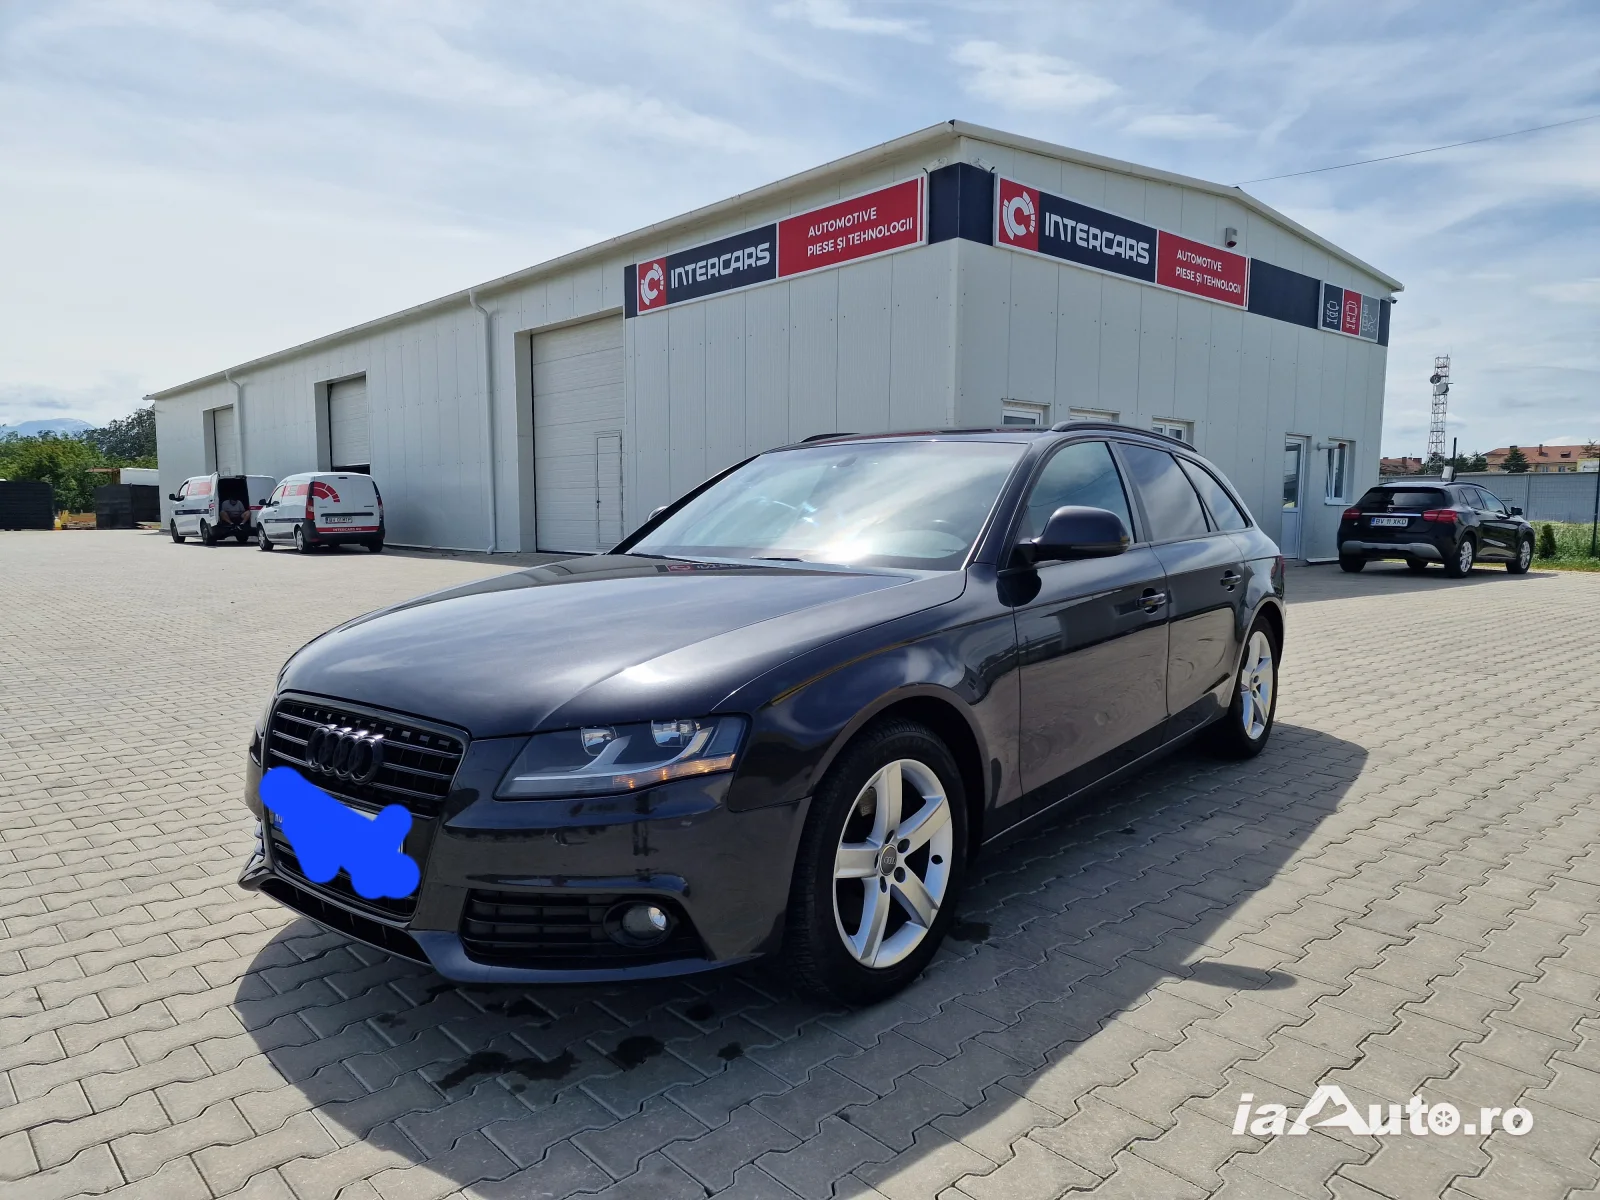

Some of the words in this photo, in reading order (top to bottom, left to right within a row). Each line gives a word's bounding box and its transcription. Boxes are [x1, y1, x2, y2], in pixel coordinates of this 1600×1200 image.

[807, 207, 877, 238] AUTOMOTIVE
[807, 237, 835, 257] PIESE
[847, 217, 913, 247] TEHNOLOGII
[1045, 212, 1149, 265] INTERCARS
[670, 242, 771, 289] INTERCARS
[1175, 266, 1195, 282] PIESE
[1177, 249, 1222, 272] AUTOMOTIVE
